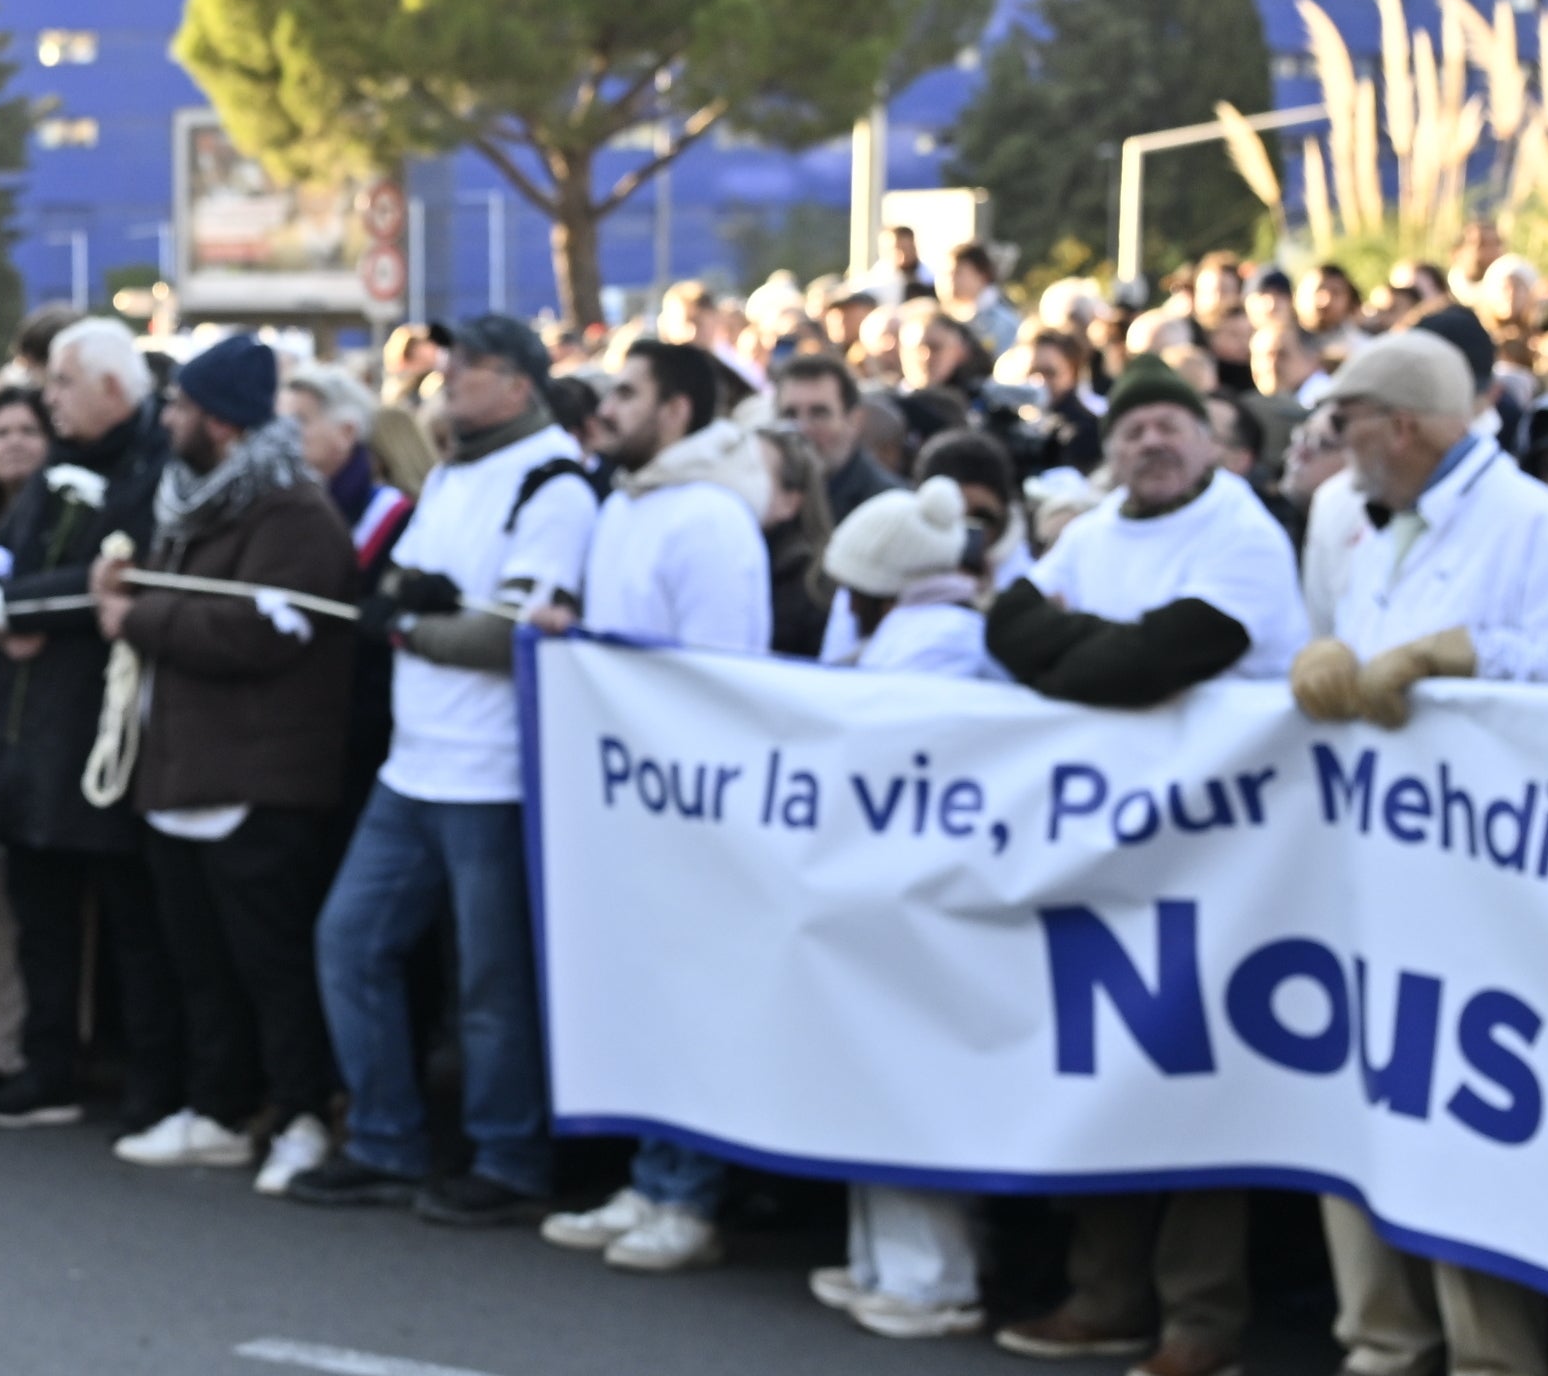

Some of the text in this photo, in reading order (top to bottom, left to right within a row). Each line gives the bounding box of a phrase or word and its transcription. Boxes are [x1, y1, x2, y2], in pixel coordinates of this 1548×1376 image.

[598, 734, 742, 826] Pour
[760, 747, 820, 829] la
[849, 750, 1011, 854] vie,
[1047, 763, 1278, 850] Pour
[1028, 896, 1545, 1148] Nous
